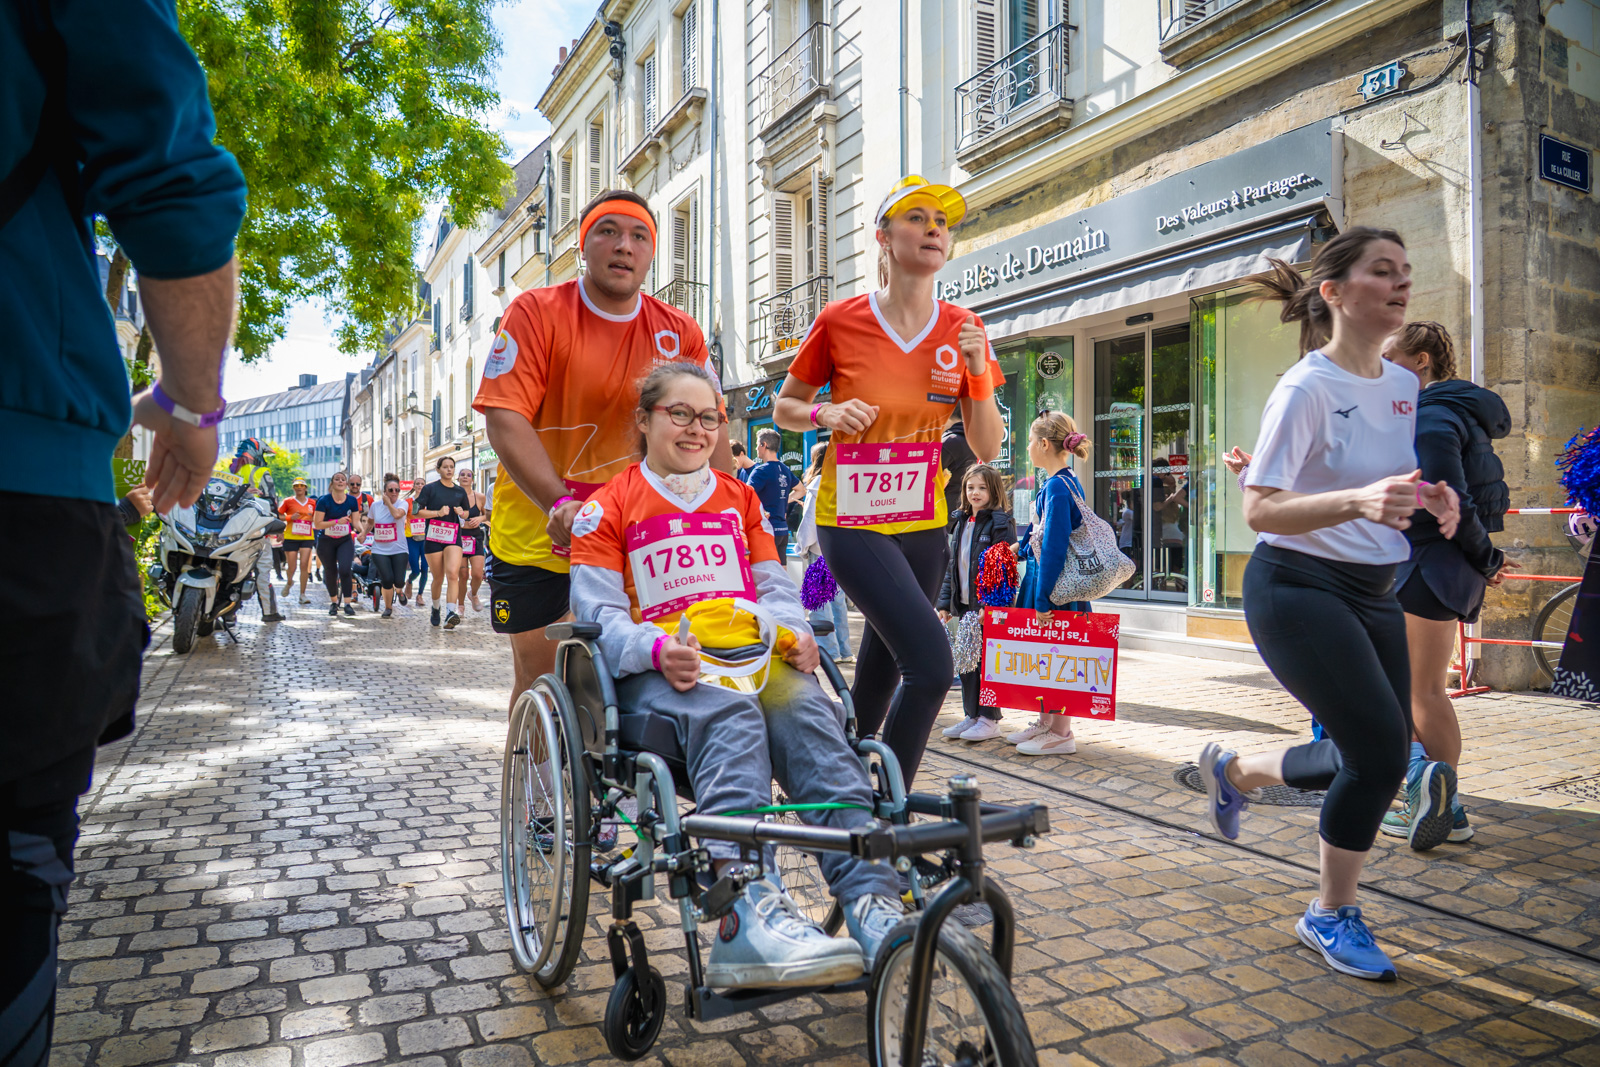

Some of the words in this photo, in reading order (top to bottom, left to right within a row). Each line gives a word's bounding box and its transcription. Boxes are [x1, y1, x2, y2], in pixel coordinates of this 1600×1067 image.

[1367, 68, 1392, 94] 31
[1561, 150, 1571, 163] RUE
[1550, 164, 1557, 174] DE
[1556, 166, 1563, 176] LA
[1562, 166, 1581, 182] CUILLER
[1155, 215, 1180, 232] Des
[1181, 202, 1228, 223] Valeurs
[1230, 190, 1240, 206] à
[1242, 172, 1316, 203] Partager...
[934, 279, 960, 300] Les
[963, 263, 997, 294] Blés
[1000, 252, 1022, 280] de
[1025, 225, 1107, 273] Demain
[931, 368, 961, 380] Harmonie
[931, 374, 960, 385] mutuelle
[746, 385, 770, 412] La
[931, 448, 940, 466] 17817
[848, 470, 920, 494] 17817
[870, 498, 897, 507] LOUISE
[431, 527, 452, 536] 18379
[642, 543, 727, 579] 17819
[663, 573, 717, 591] ELEOBANE
[1007, 626, 1041, 638] rapide
[1054, 620, 1070, 629] de
[1043, 628, 1065, 641] l'air
[1067, 631, 1090, 643] T'as
[994, 643, 1002, 675] !
[1055, 653, 1112, 687] ALLEZ
